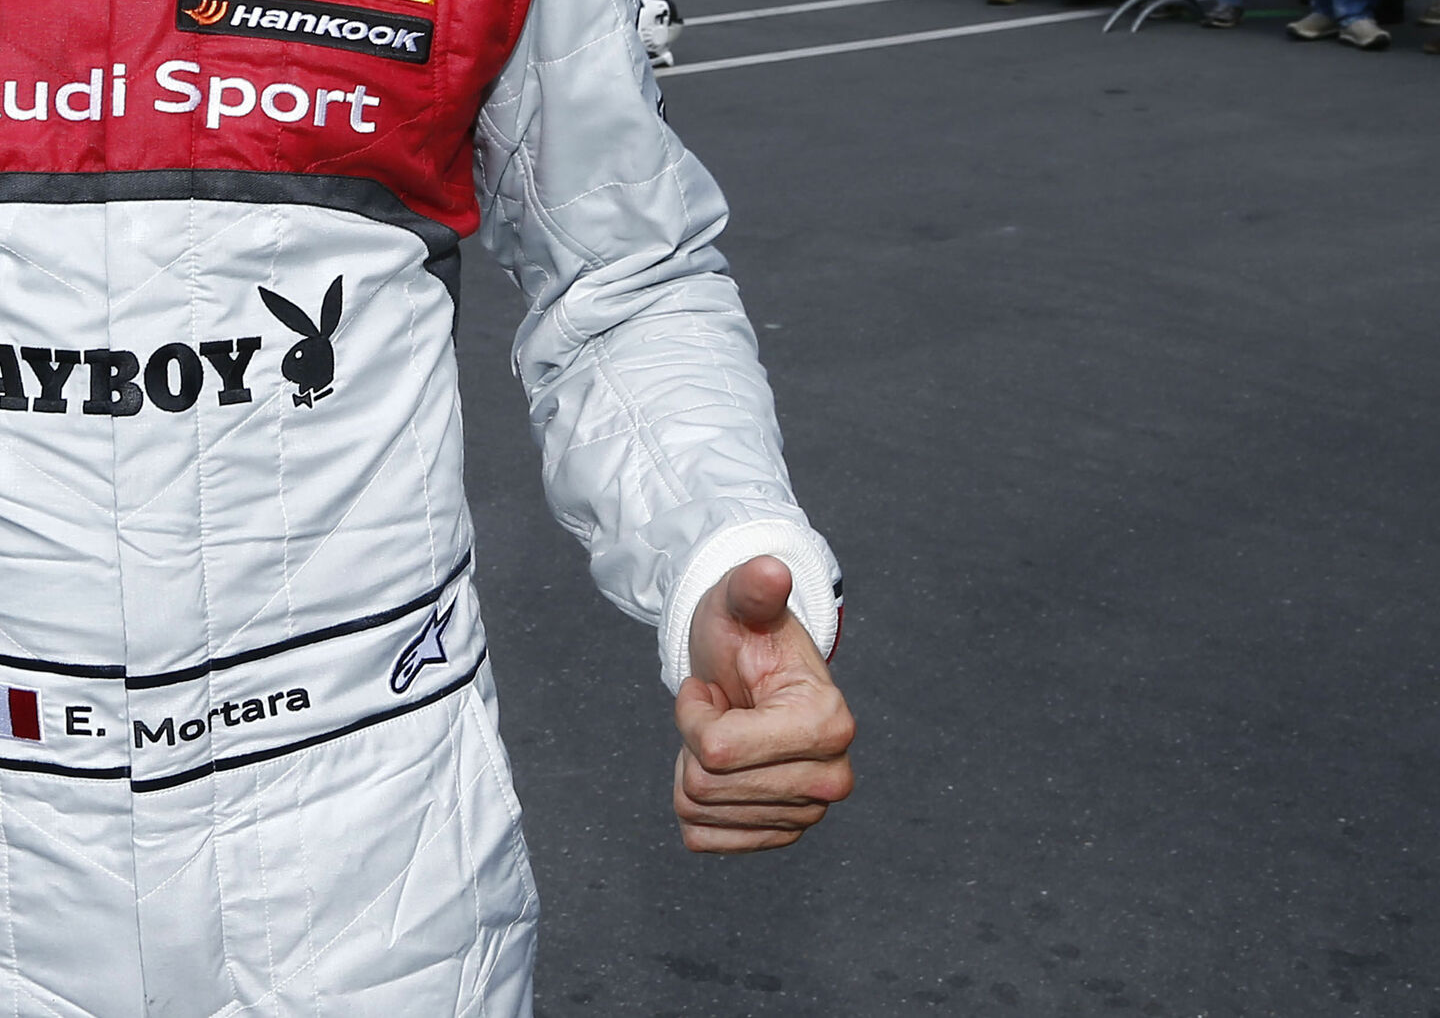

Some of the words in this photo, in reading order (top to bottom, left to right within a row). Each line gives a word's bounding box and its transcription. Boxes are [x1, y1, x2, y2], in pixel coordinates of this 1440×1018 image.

[154, 59, 381, 134] Sport
[65, 706, 106, 738] E.
[133, 687, 311, 749] Mortara
